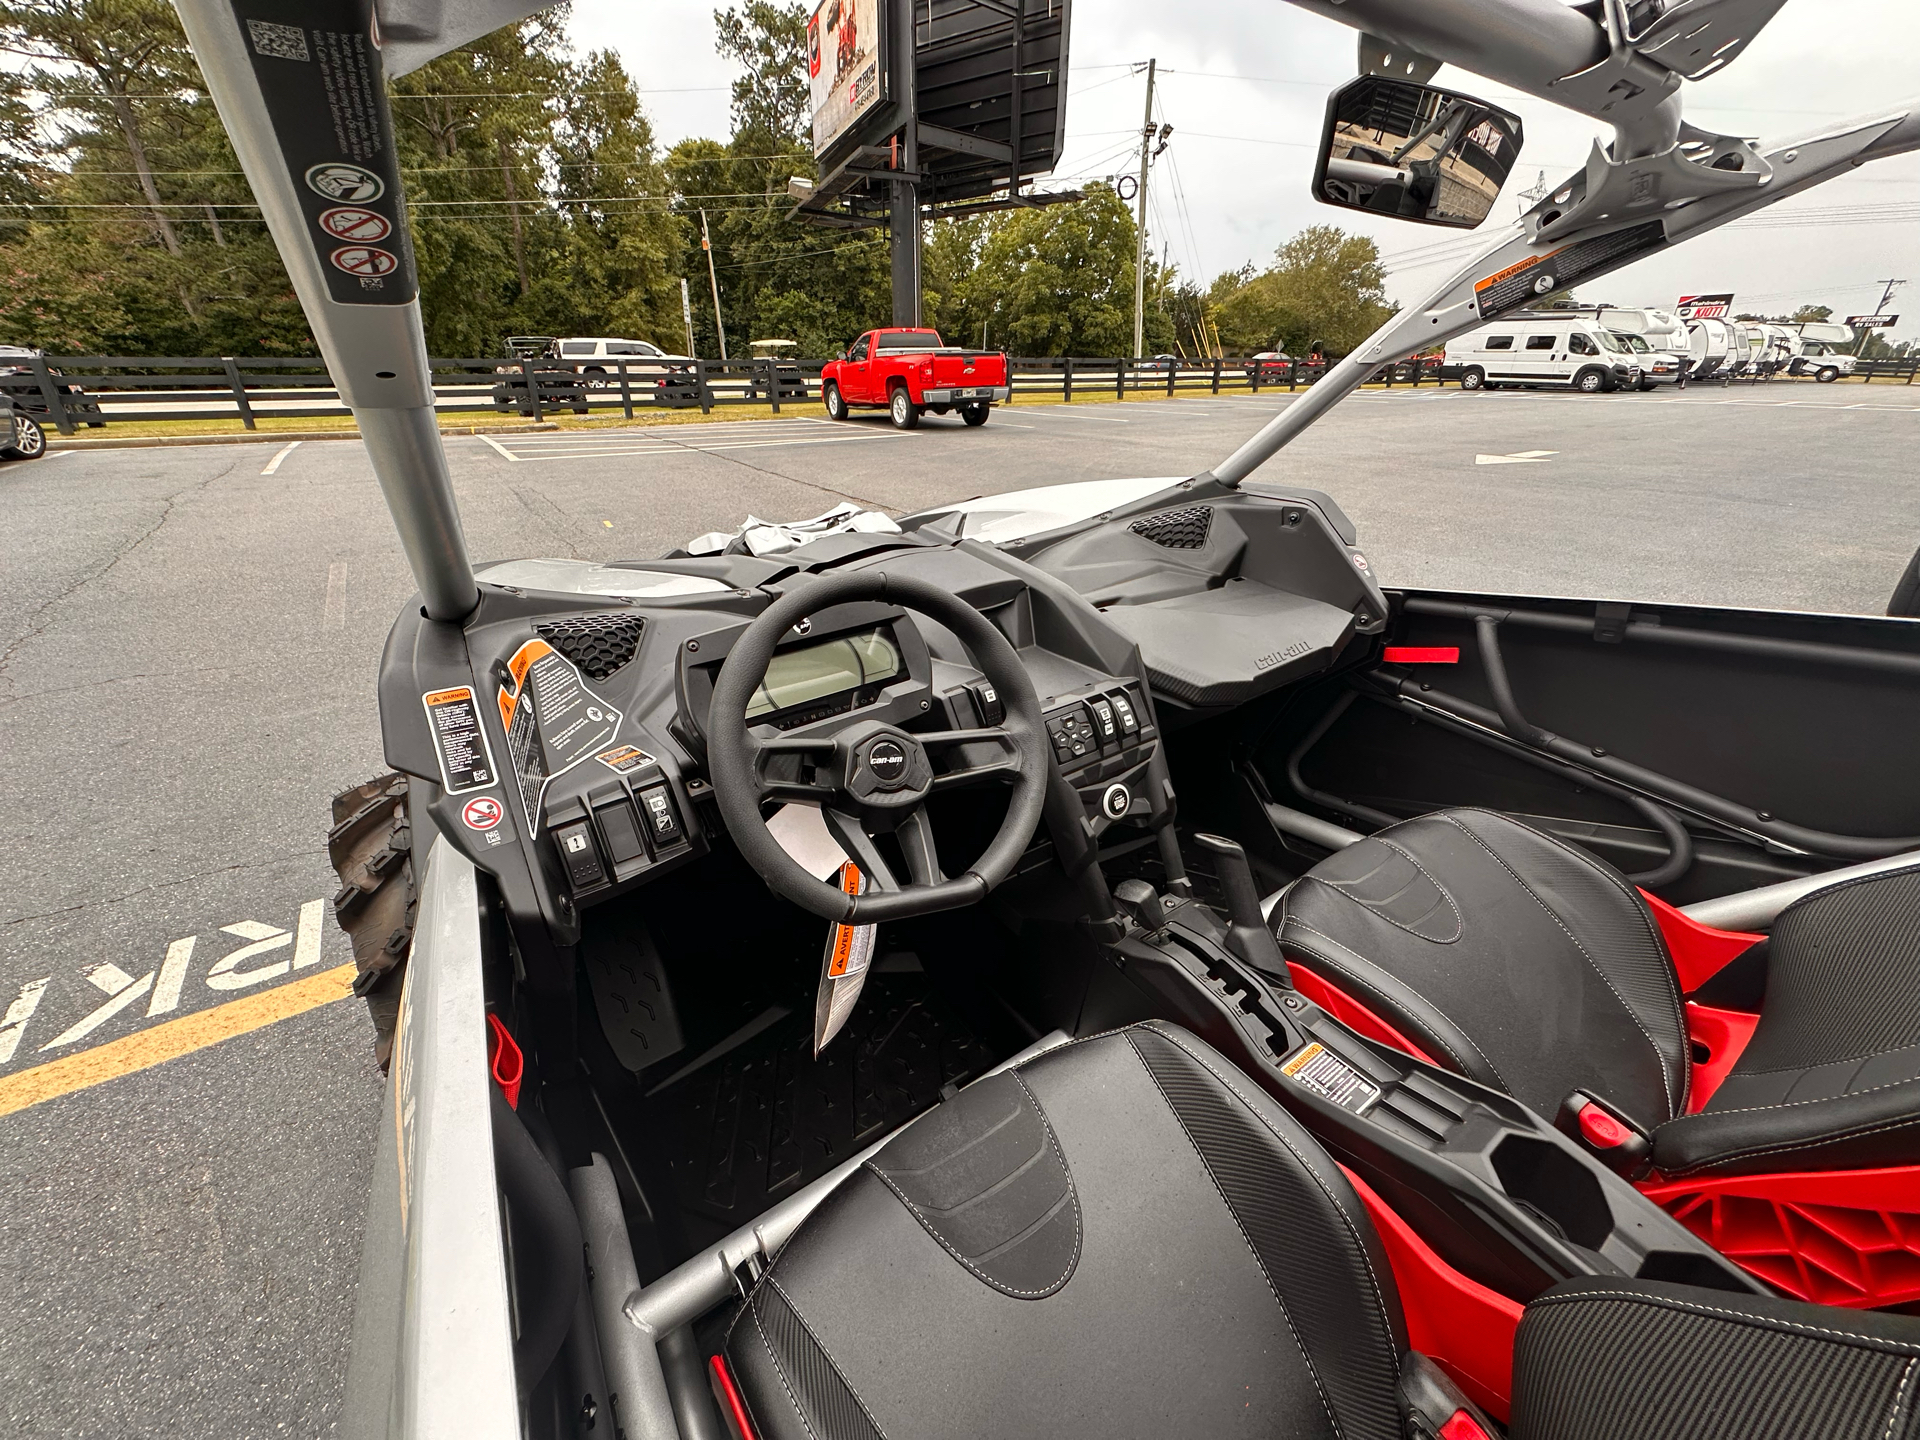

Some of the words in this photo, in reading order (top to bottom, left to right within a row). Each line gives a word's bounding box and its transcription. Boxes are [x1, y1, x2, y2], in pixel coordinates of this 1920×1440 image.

[1498, 258, 1538, 280] WARNING
[1693, 306, 1724, 318] KIOTI
[515, 656, 527, 682] WARNING
[441, 692, 468, 700] WARNING
[870, 756, 904, 765] can-am
[1294, 1047, 1319, 1070] WARNING
